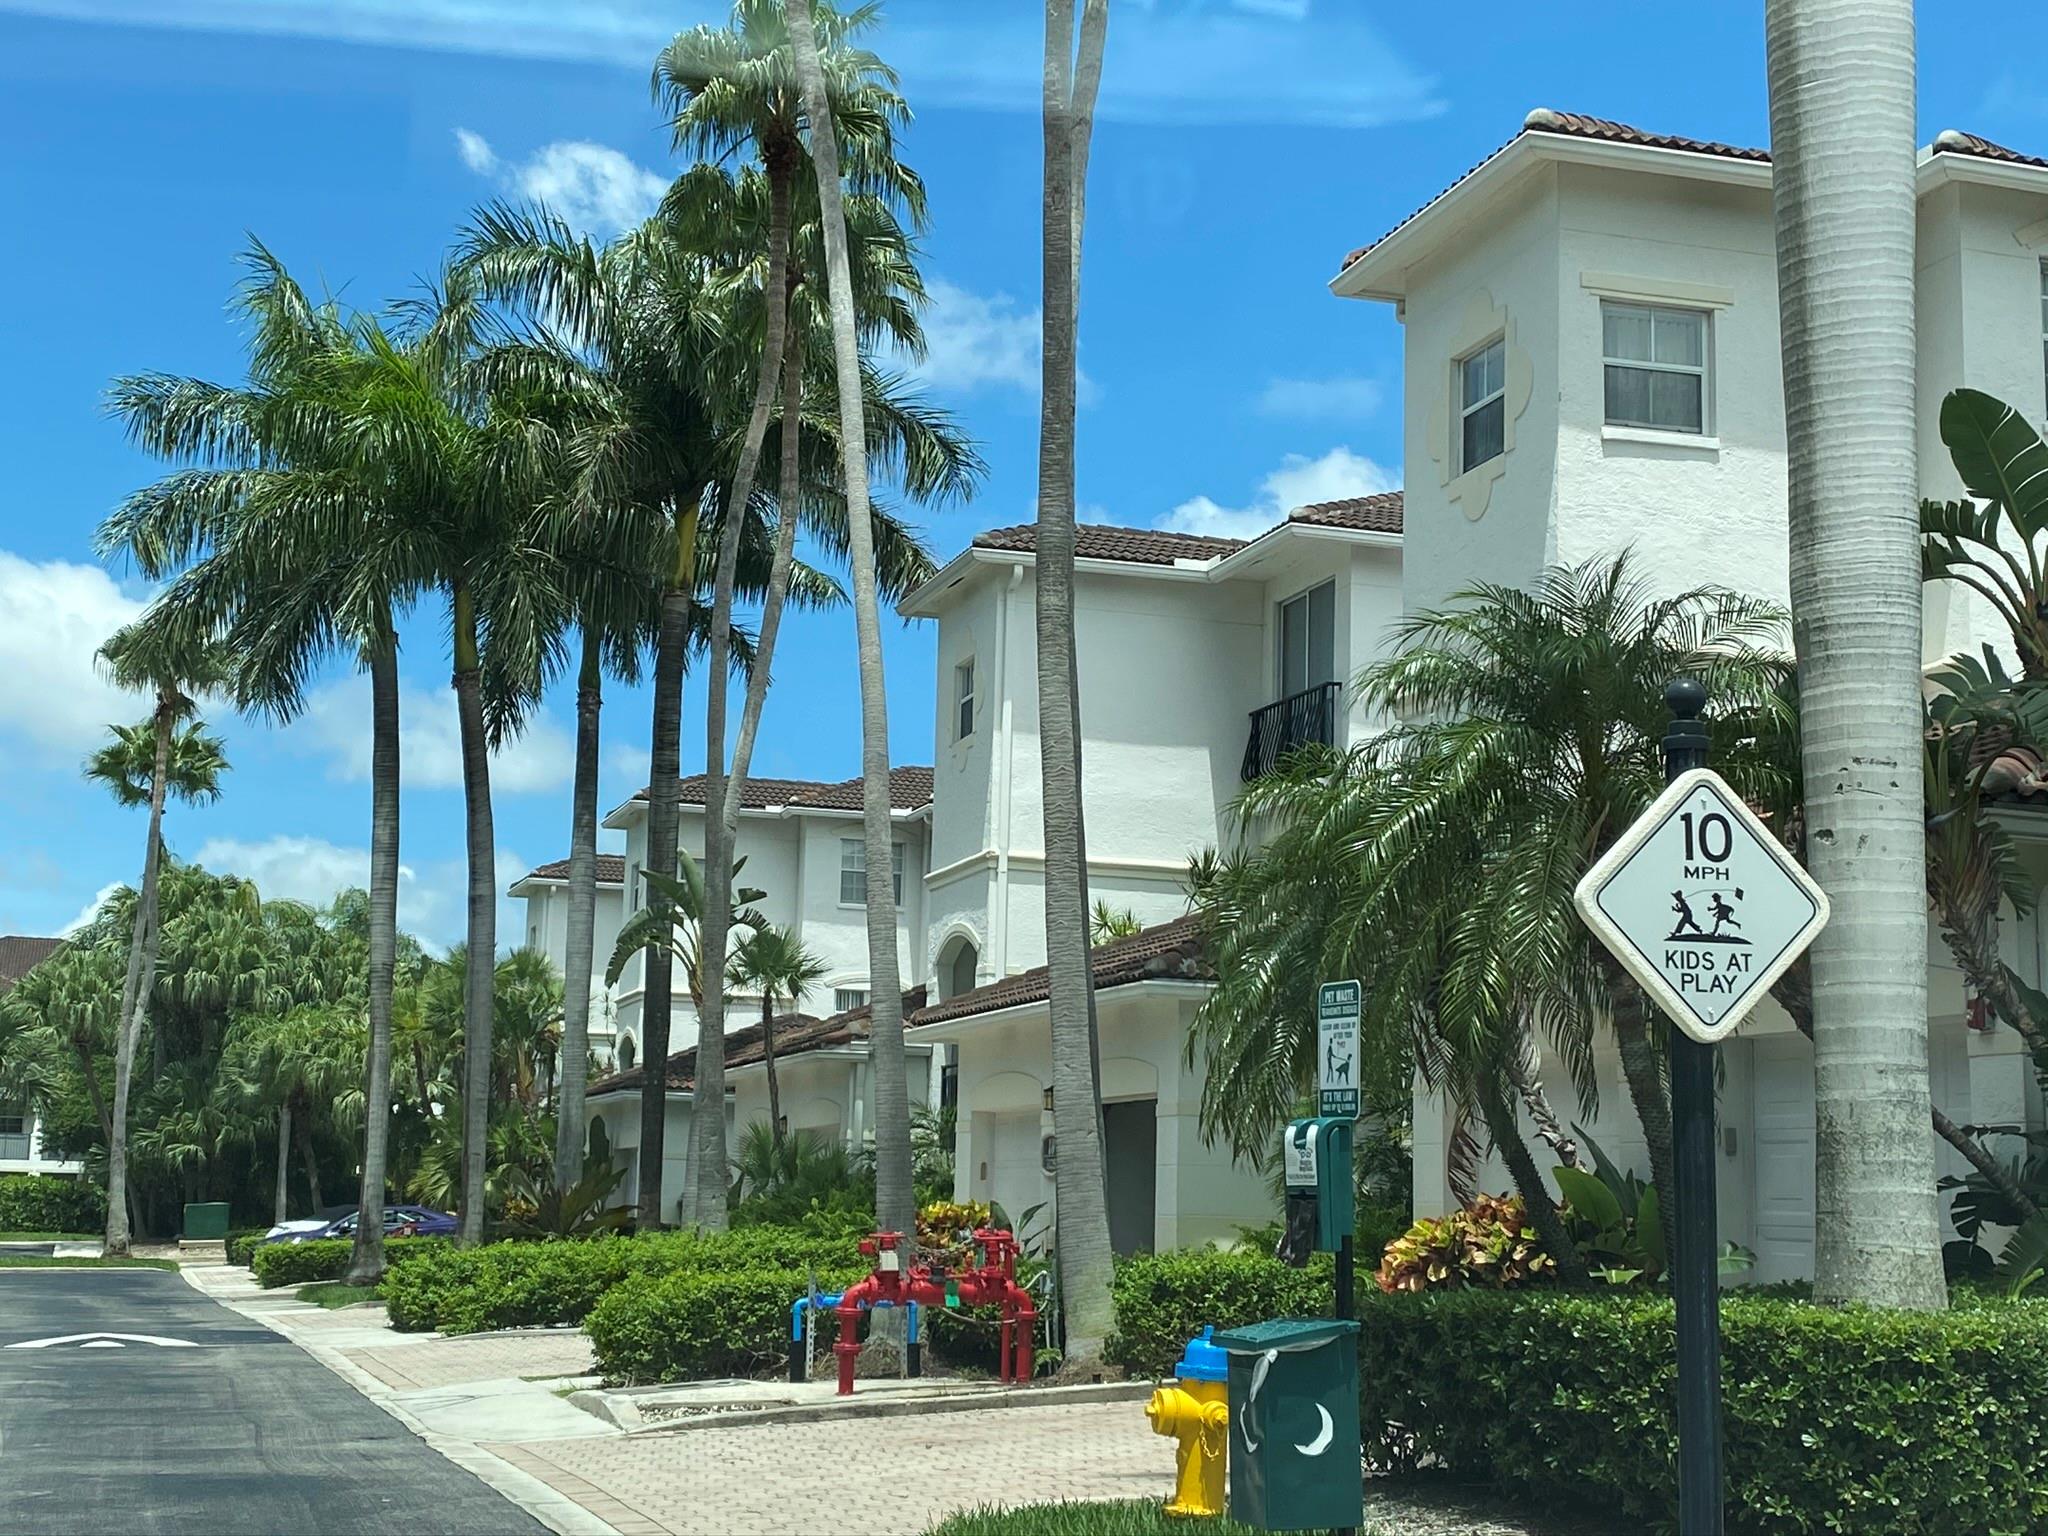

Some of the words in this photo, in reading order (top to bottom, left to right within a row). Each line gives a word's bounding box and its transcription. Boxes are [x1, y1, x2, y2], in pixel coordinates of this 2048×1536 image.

[1680, 812, 1733, 863] 10
[1684, 866, 1730, 880] MPH
[1666, 950, 1714, 970] KIDS
[1727, 953, 1753, 973] AT
[1681, 973, 1738, 993] PLAY
[1324, 991, 1335, 1003] PET
